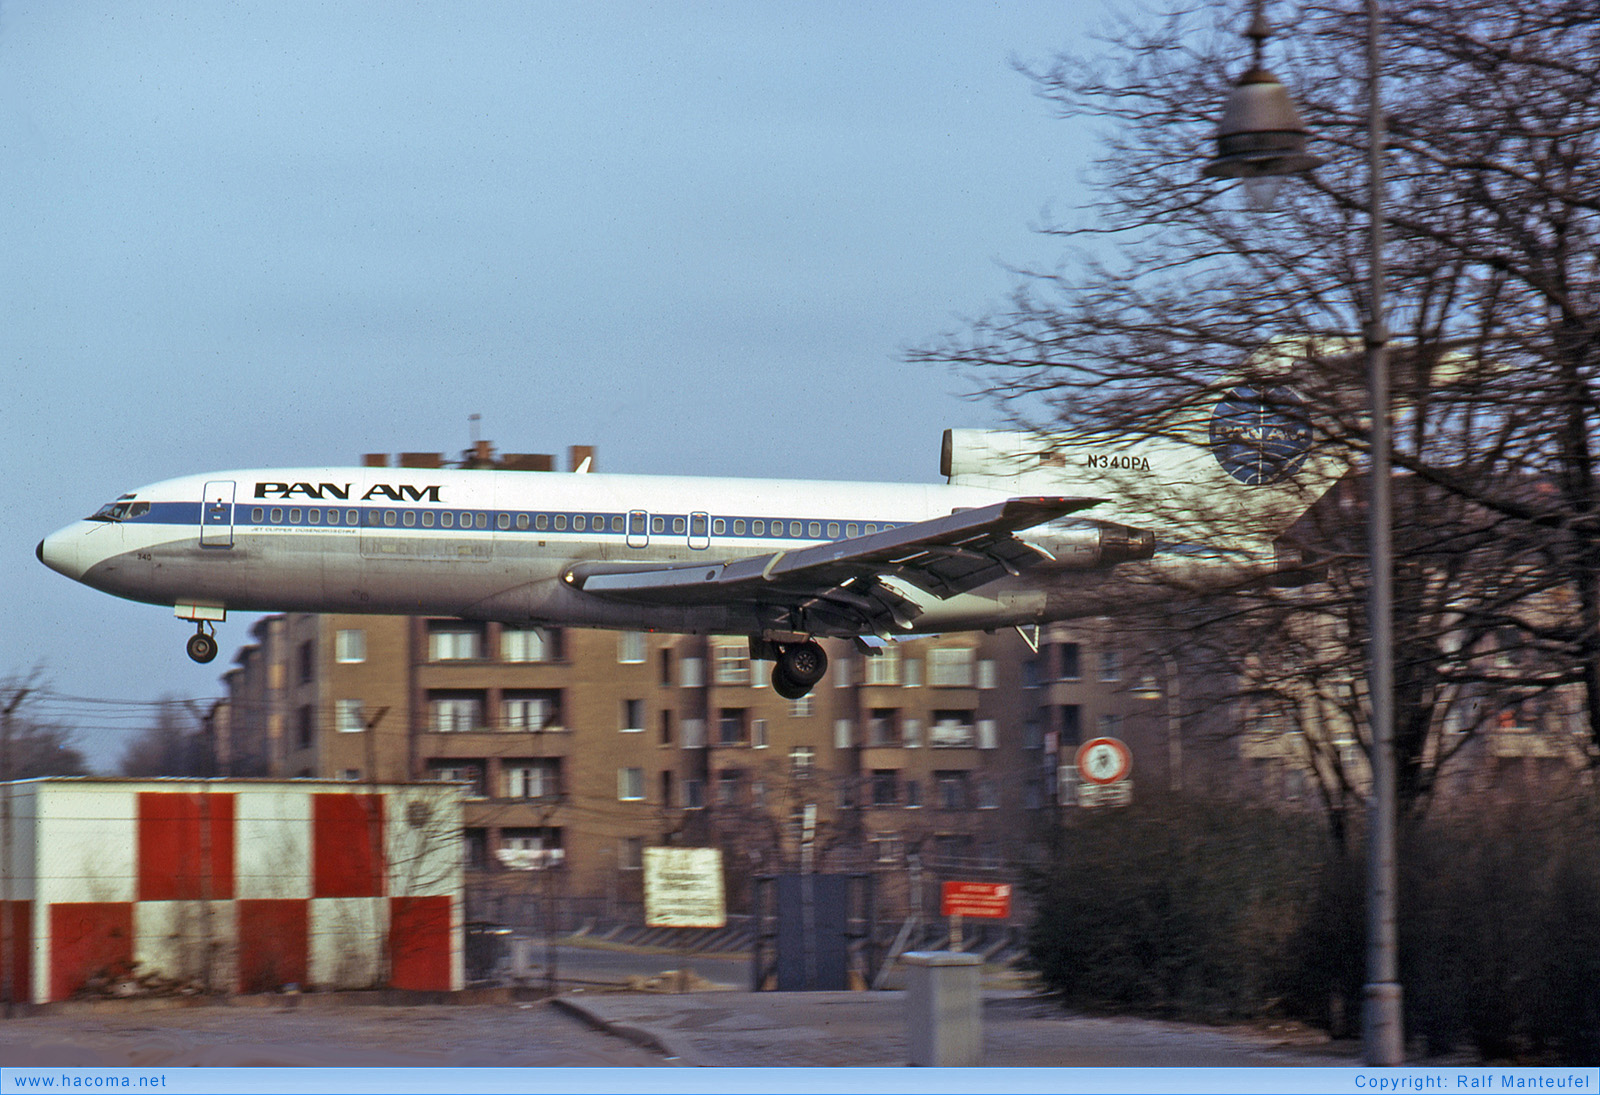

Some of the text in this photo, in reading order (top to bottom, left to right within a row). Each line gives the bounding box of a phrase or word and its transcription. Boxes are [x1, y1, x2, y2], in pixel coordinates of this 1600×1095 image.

[1087, 454, 1151, 471] N340PA
[254, 482, 442, 503] PAN AM
[137, 552, 152, 561] 340
